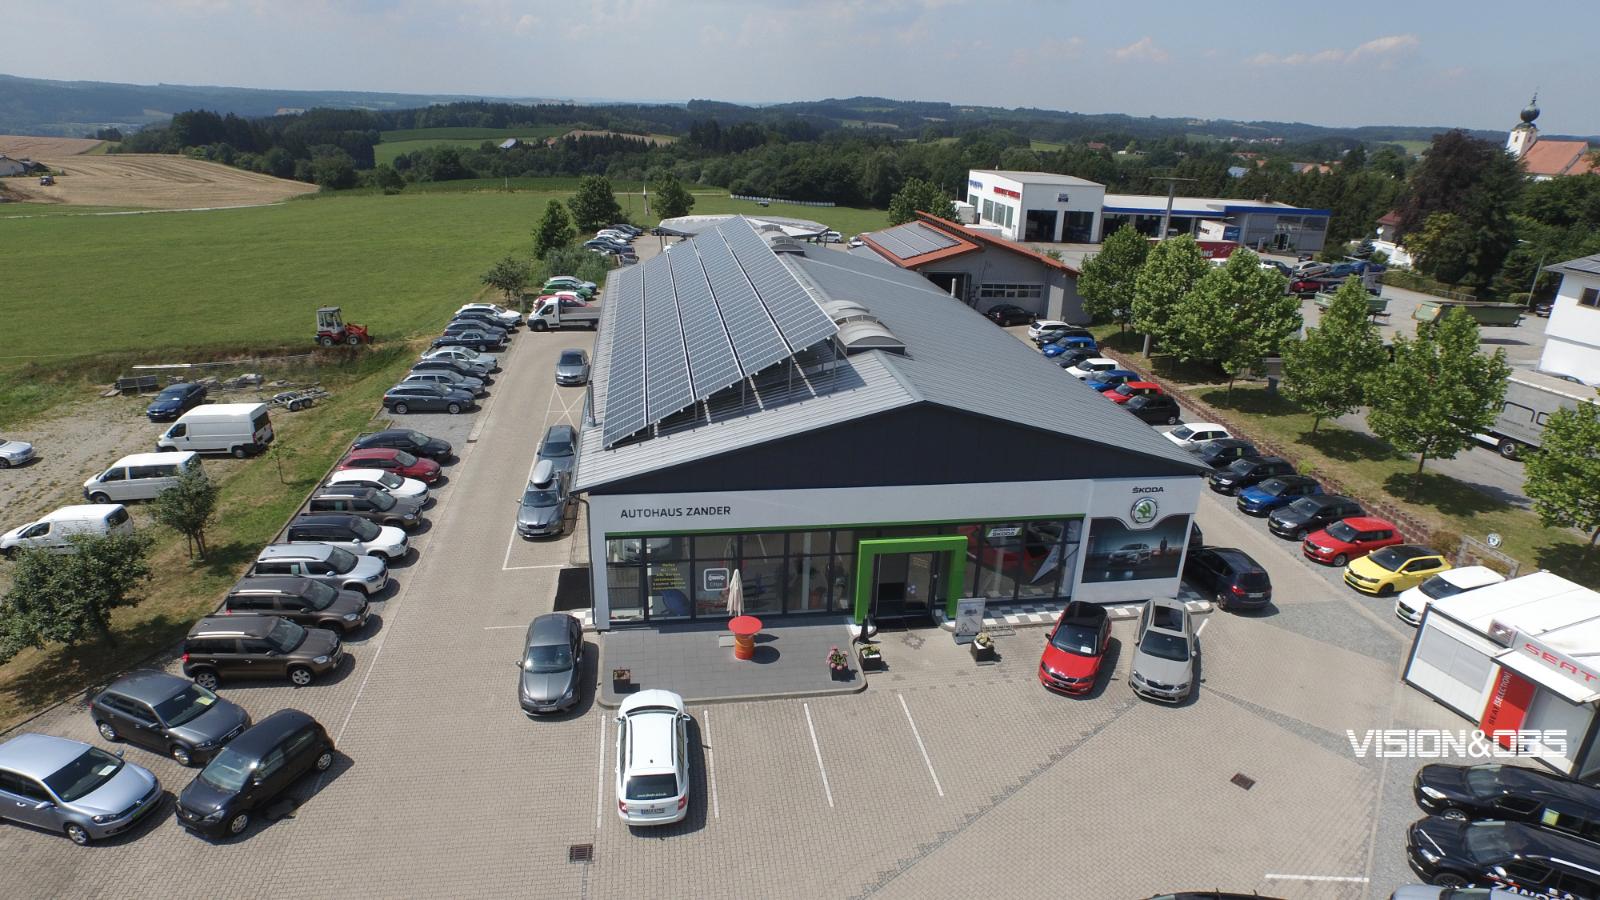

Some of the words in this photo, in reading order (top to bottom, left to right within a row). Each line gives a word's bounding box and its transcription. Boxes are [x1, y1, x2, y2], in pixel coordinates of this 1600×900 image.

[1132, 486, 1164, 494] ŠKODA
[620, 507, 682, 518] AUTOHAUS
[686, 506, 731, 516] ZANDER
[1524, 643, 1599, 682] SEAT
